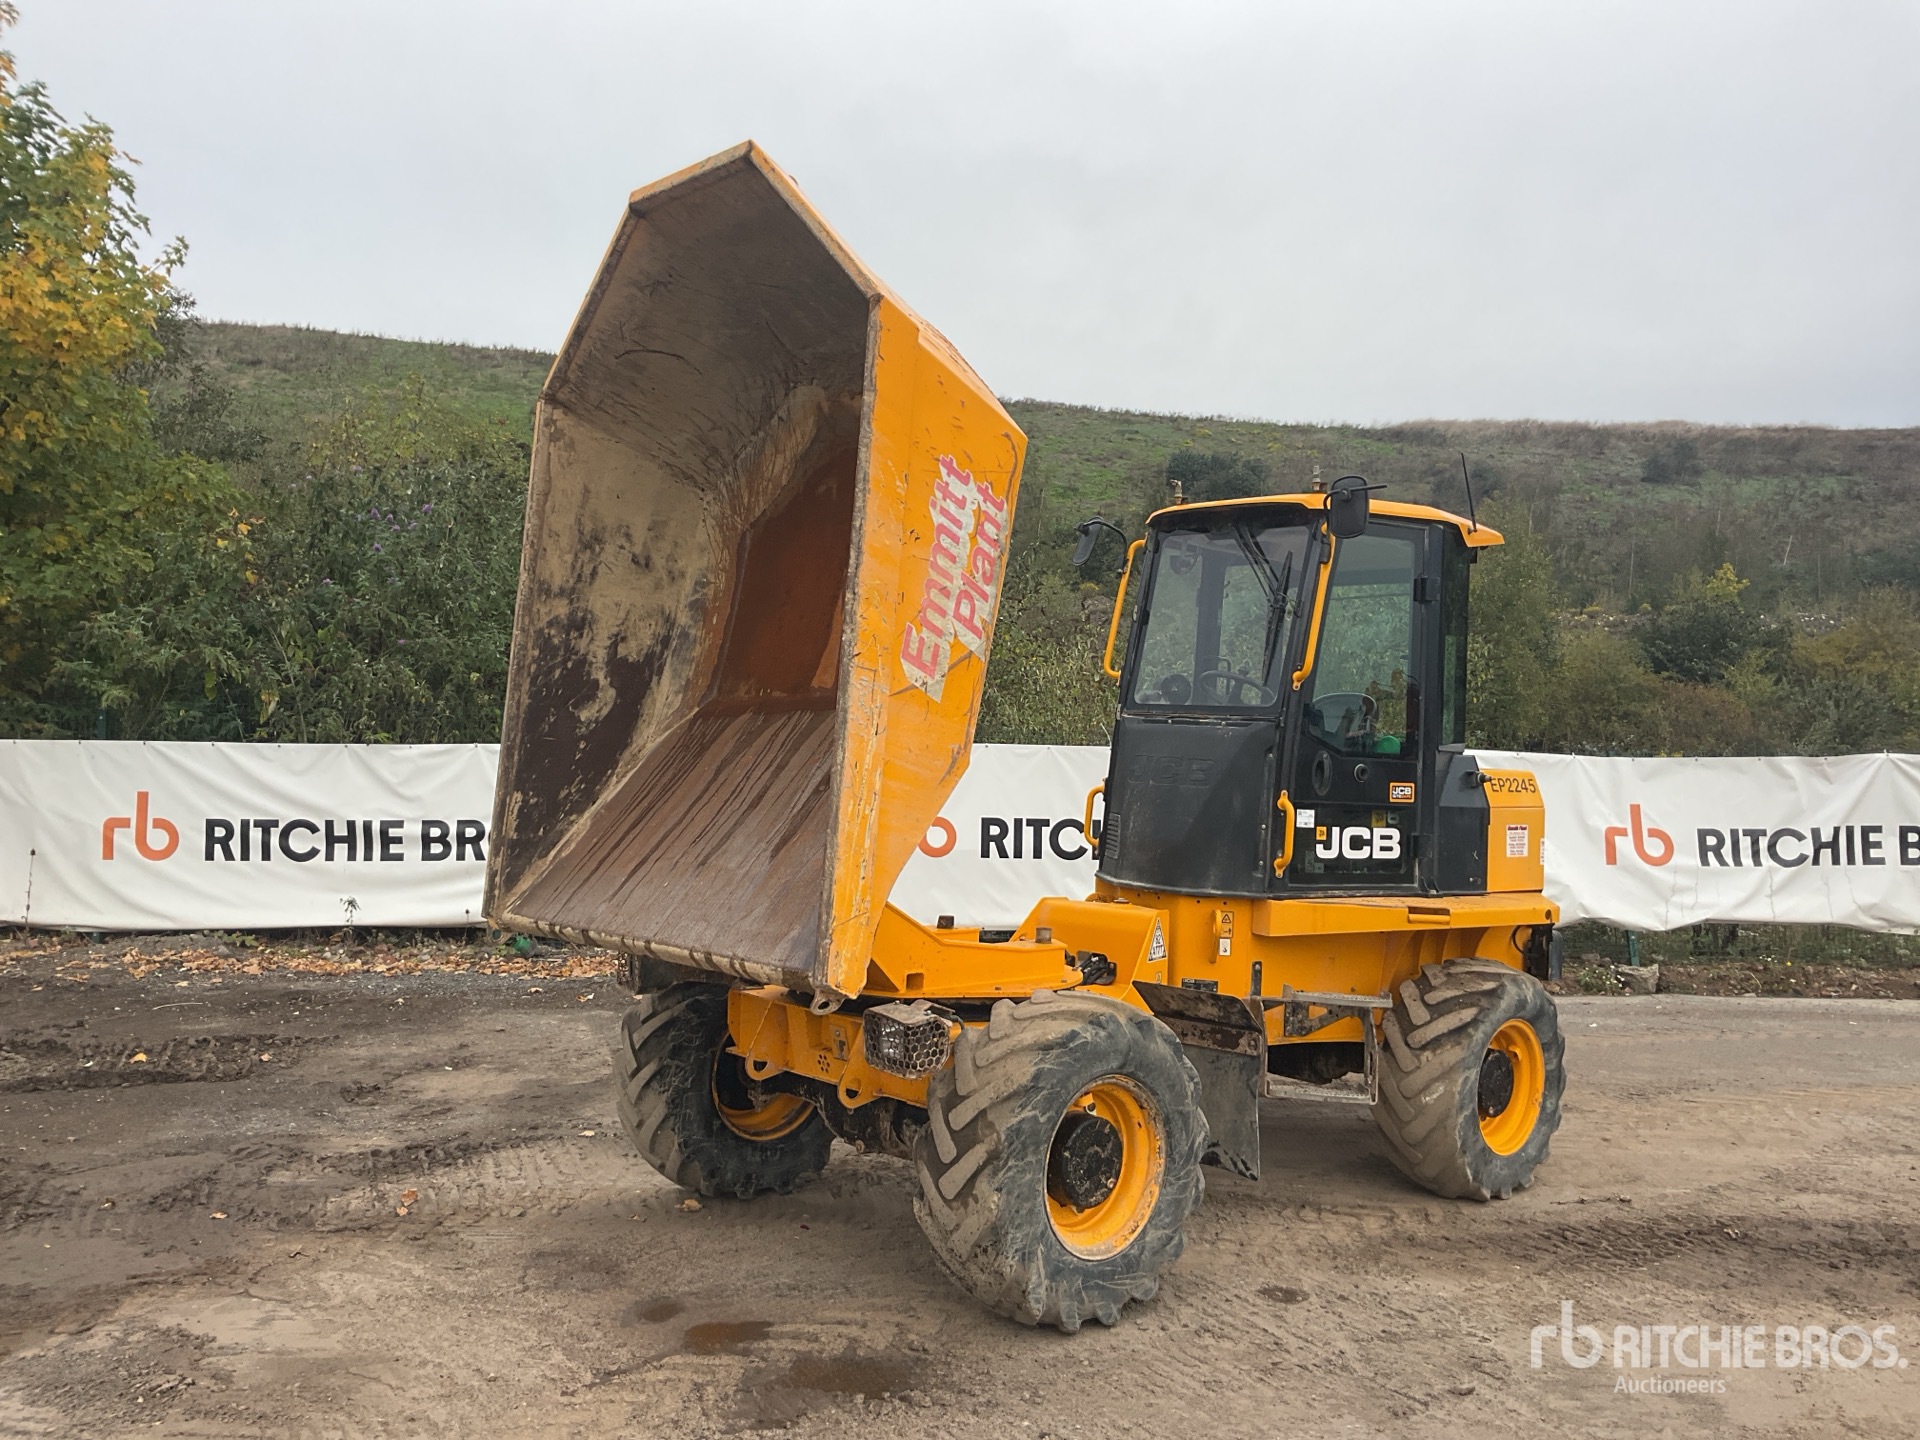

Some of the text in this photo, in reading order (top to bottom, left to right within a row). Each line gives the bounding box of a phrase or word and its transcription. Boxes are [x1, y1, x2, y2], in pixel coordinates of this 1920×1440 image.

[900, 455, 972, 680] Emmitt
[952, 481, 1006, 641] Plant
[1392, 786, 1411, 795] JCB
[1490, 777, 1536, 793] EP2245
[102, 791, 179, 862] rb
[204, 818, 490, 862] RITCHIE BR
[1315, 826, 1401, 859] JCB
[1605, 803, 1674, 867] rb
[1697, 825, 1887, 868] RITCHIE
